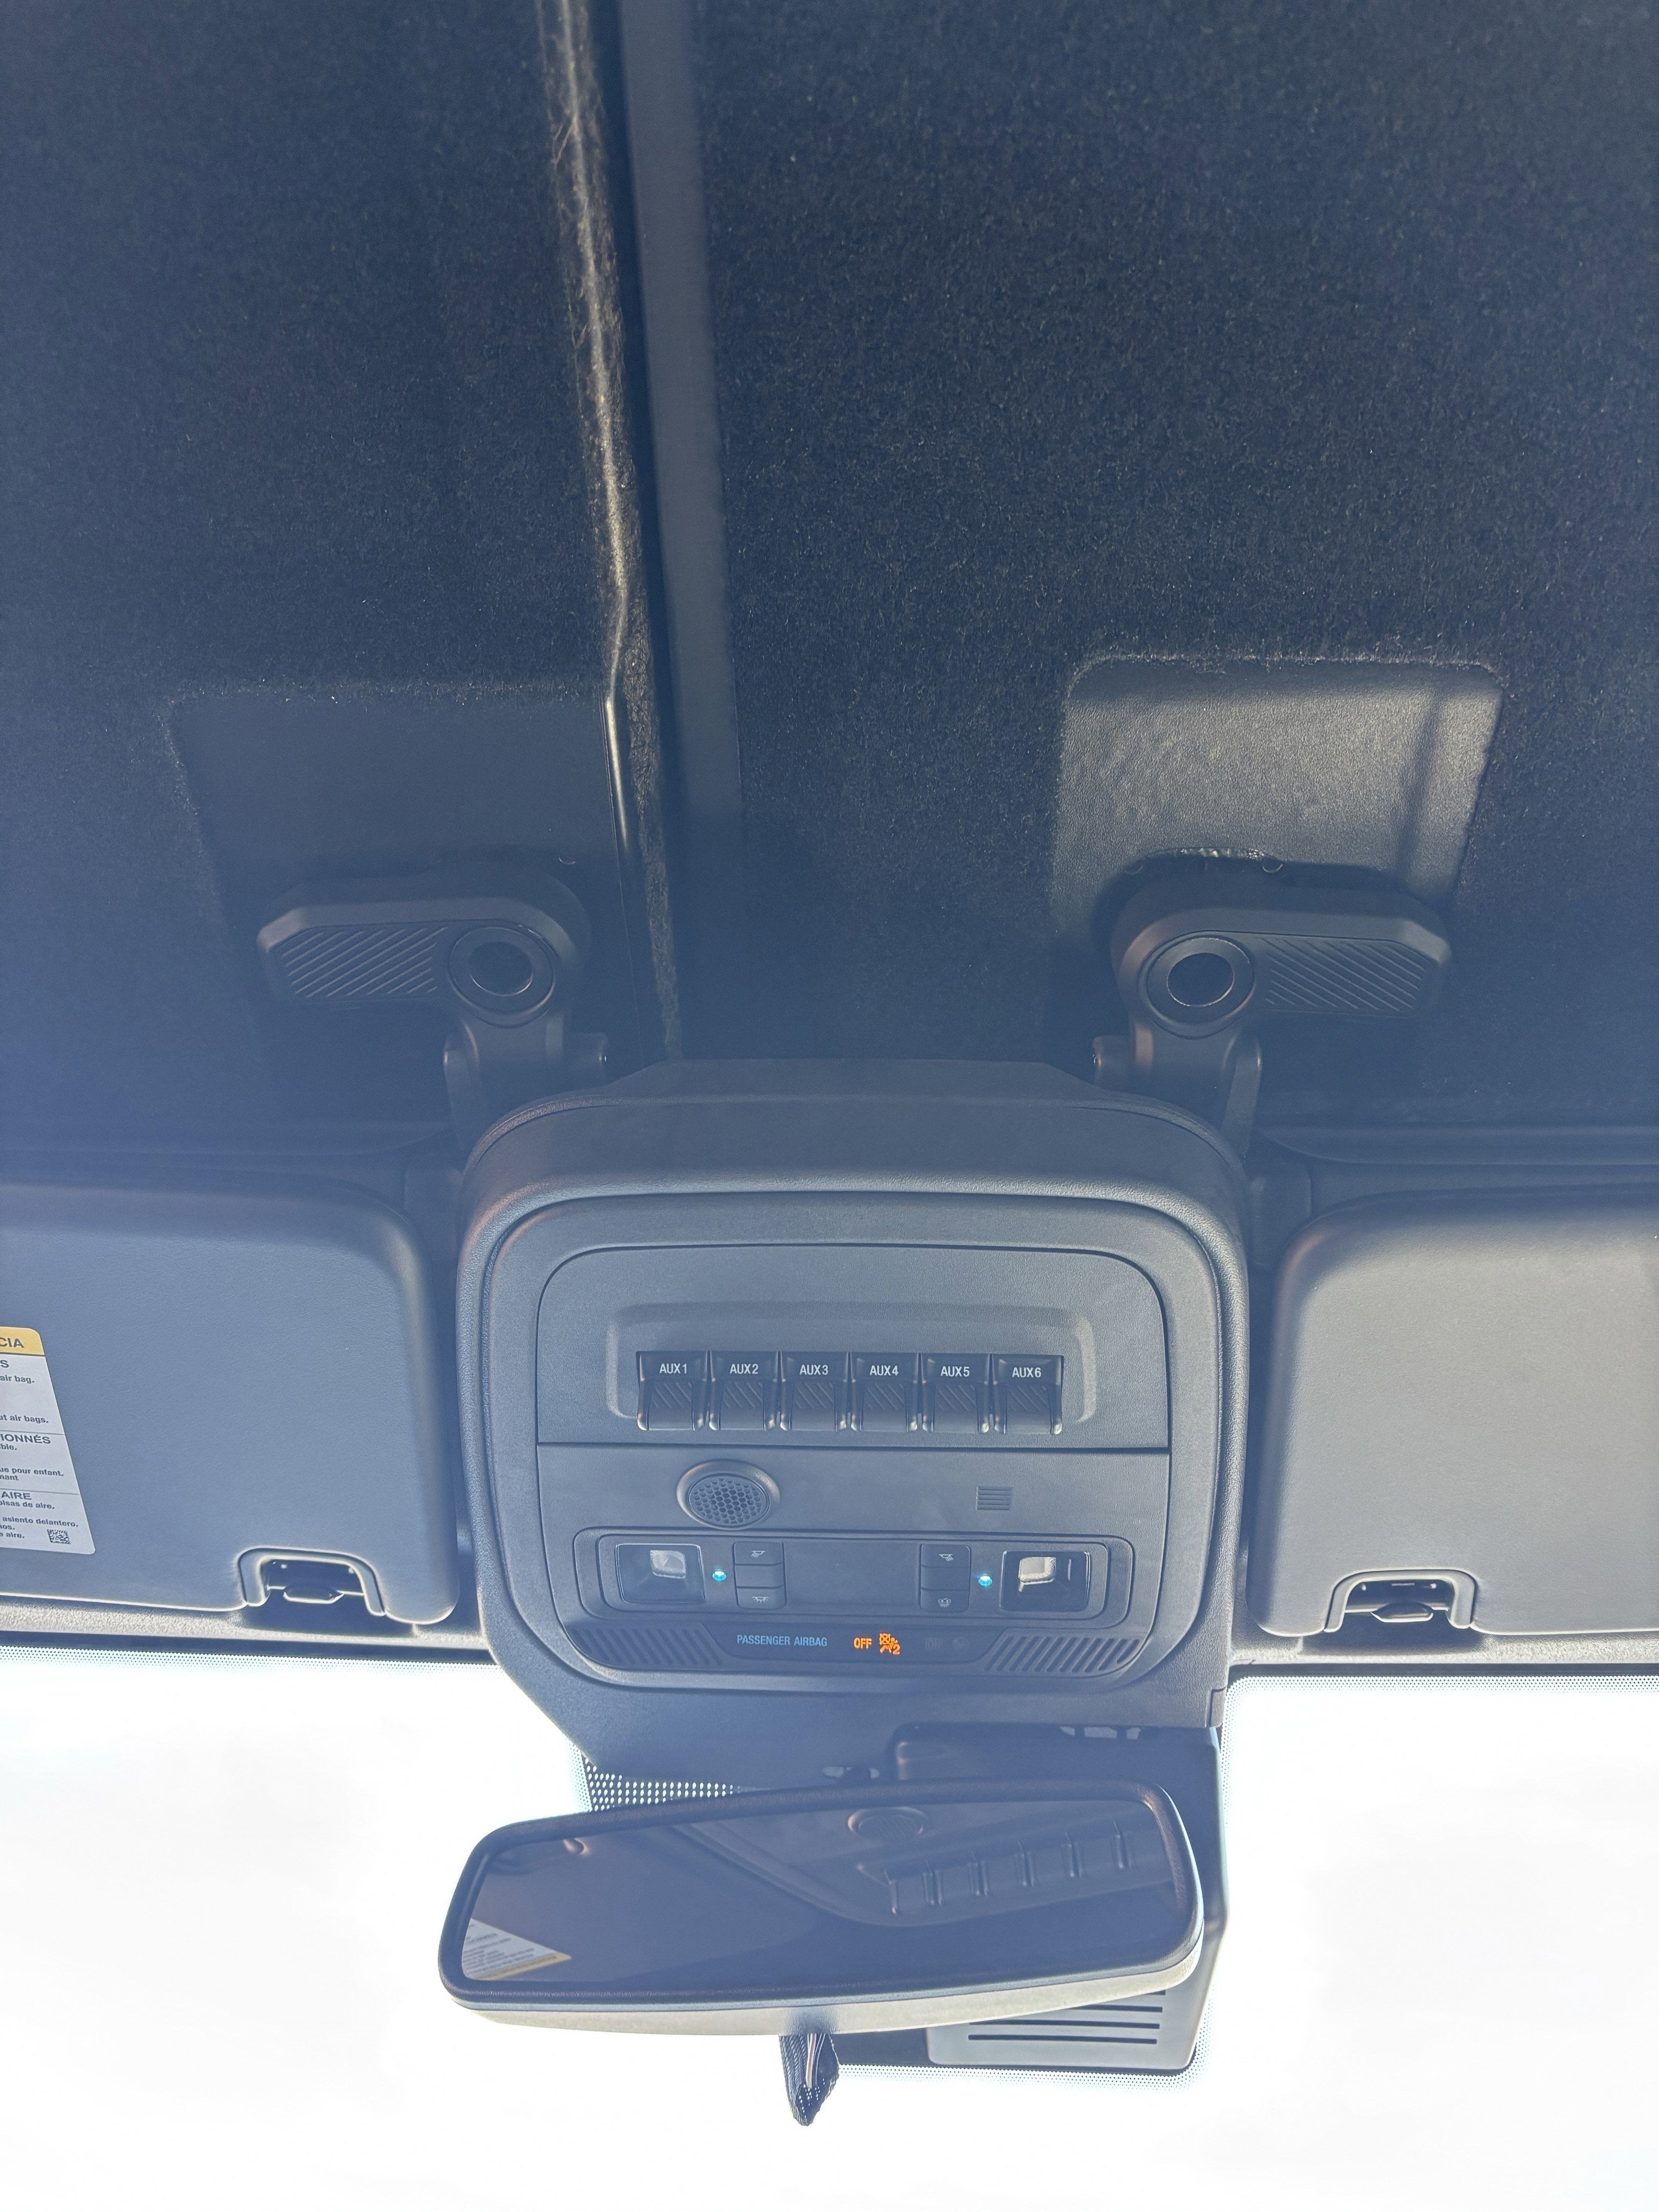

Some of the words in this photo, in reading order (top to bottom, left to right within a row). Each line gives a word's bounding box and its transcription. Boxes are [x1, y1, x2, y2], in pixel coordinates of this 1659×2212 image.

[14, 1375, 34, 1384] bag.
[24, 1415, 48, 1423] bags.
[1, 1434, 51, 1444] IONNÉS
[2, 1492, 32, 1500] AIRE
[36, 1519, 78, 1527] delantero.
[737, 1634, 791, 1645] PASSENGER
[794, 1636, 827, 1647] AIRBAG
[854, 1637, 872, 1649] OFF
